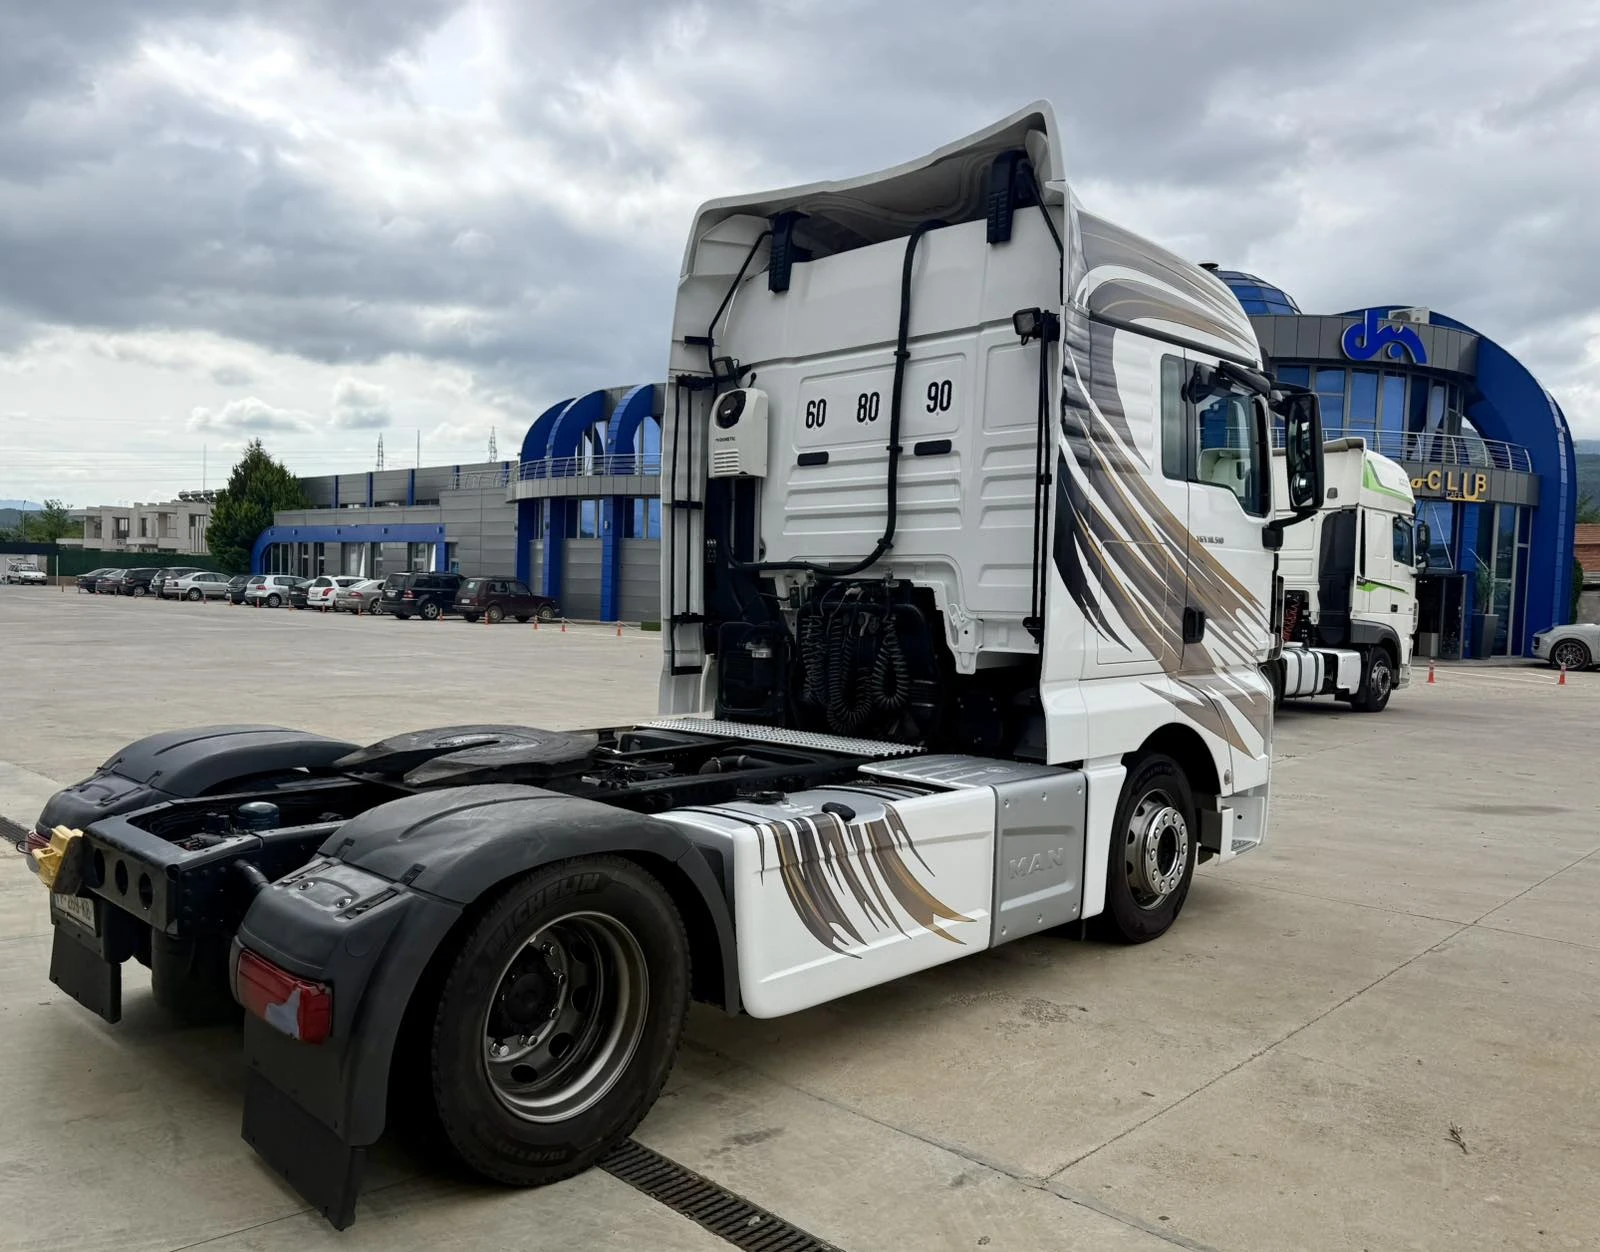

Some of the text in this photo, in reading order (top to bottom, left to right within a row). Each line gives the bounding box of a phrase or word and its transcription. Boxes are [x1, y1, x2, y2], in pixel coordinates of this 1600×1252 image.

[856, 391, 880, 423] 80
[926, 379, 952, 413] 90
[805, 398, 827, 429] 60
[1008, 847, 1064, 879] MAN
